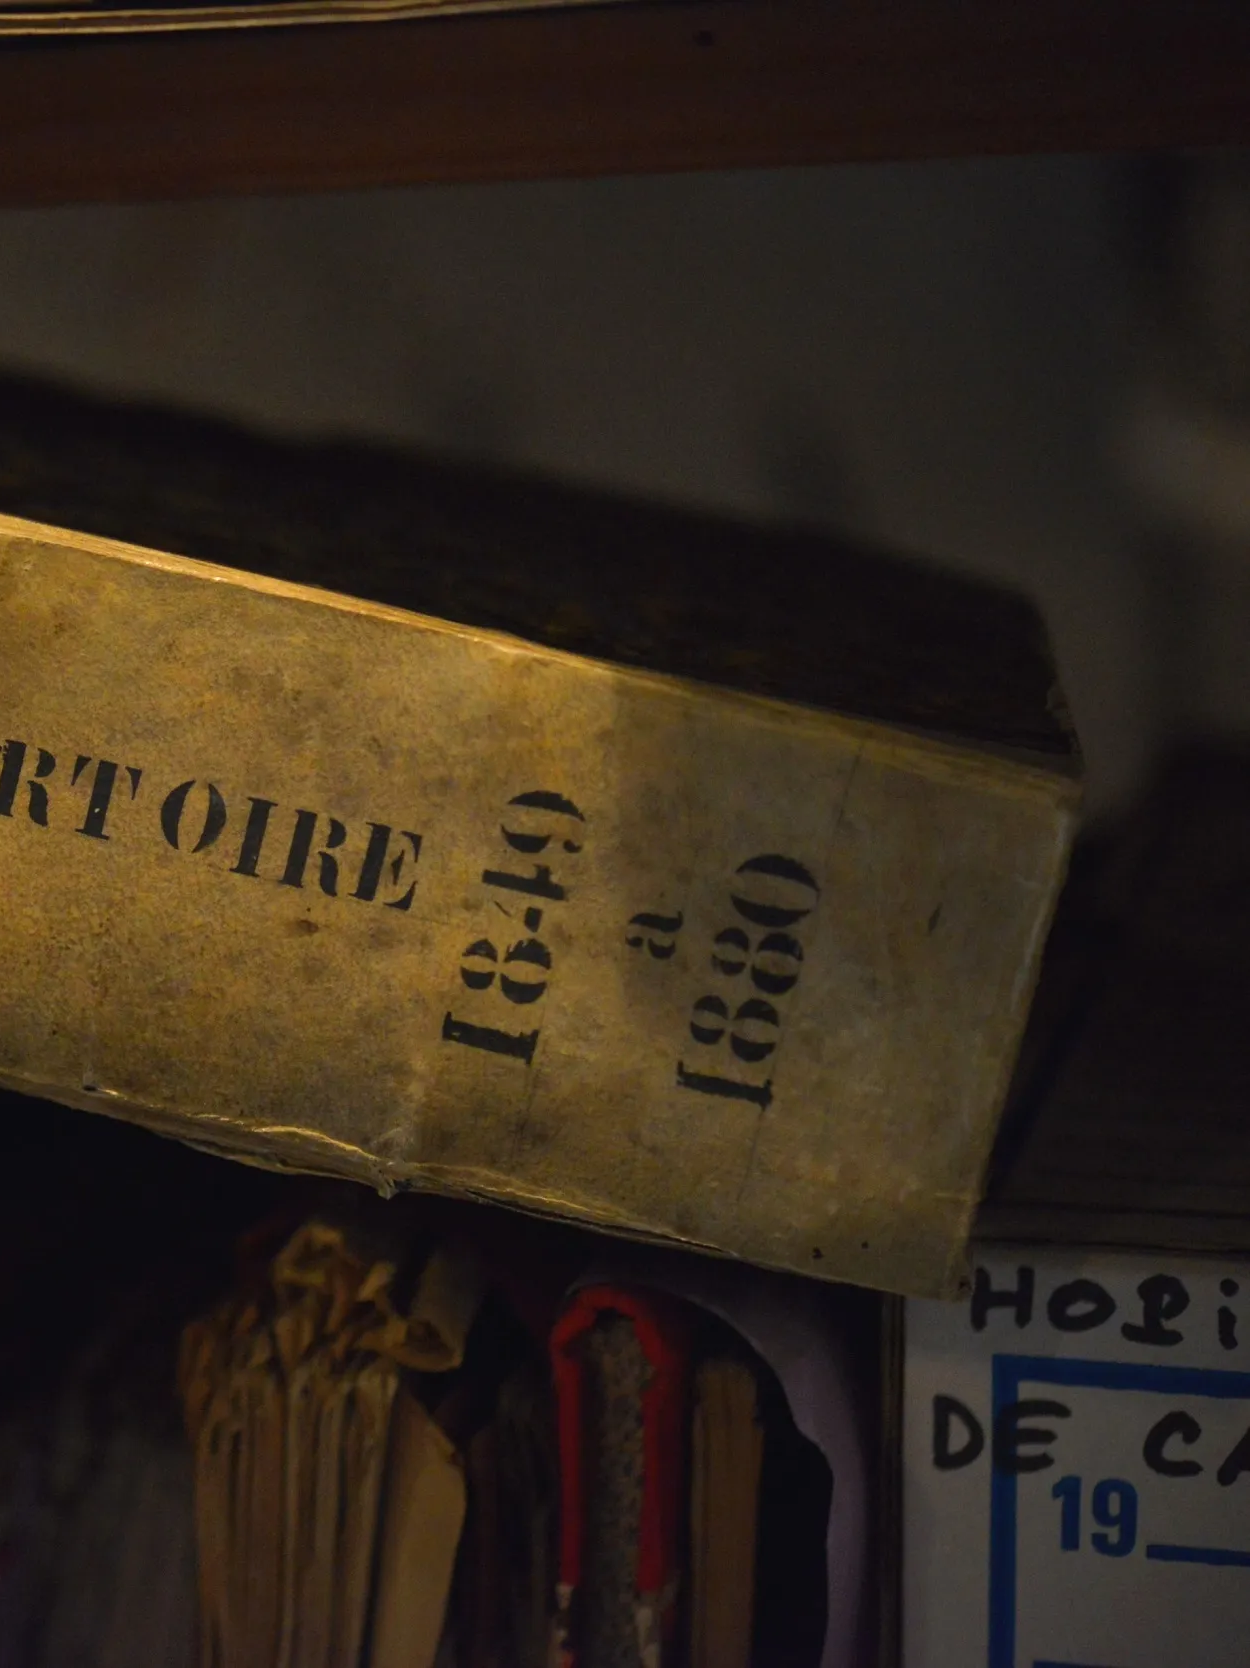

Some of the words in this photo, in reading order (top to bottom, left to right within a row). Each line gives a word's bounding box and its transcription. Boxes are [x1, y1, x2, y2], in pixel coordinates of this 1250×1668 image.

[441, 789, 586, 1067] 1849
[624, 910, 684, 960] a
[675, 853, 822, 1112] 1880
[932, 1393, 1073, 1475] DE
[1051, 1474, 1139, 1558] 19
